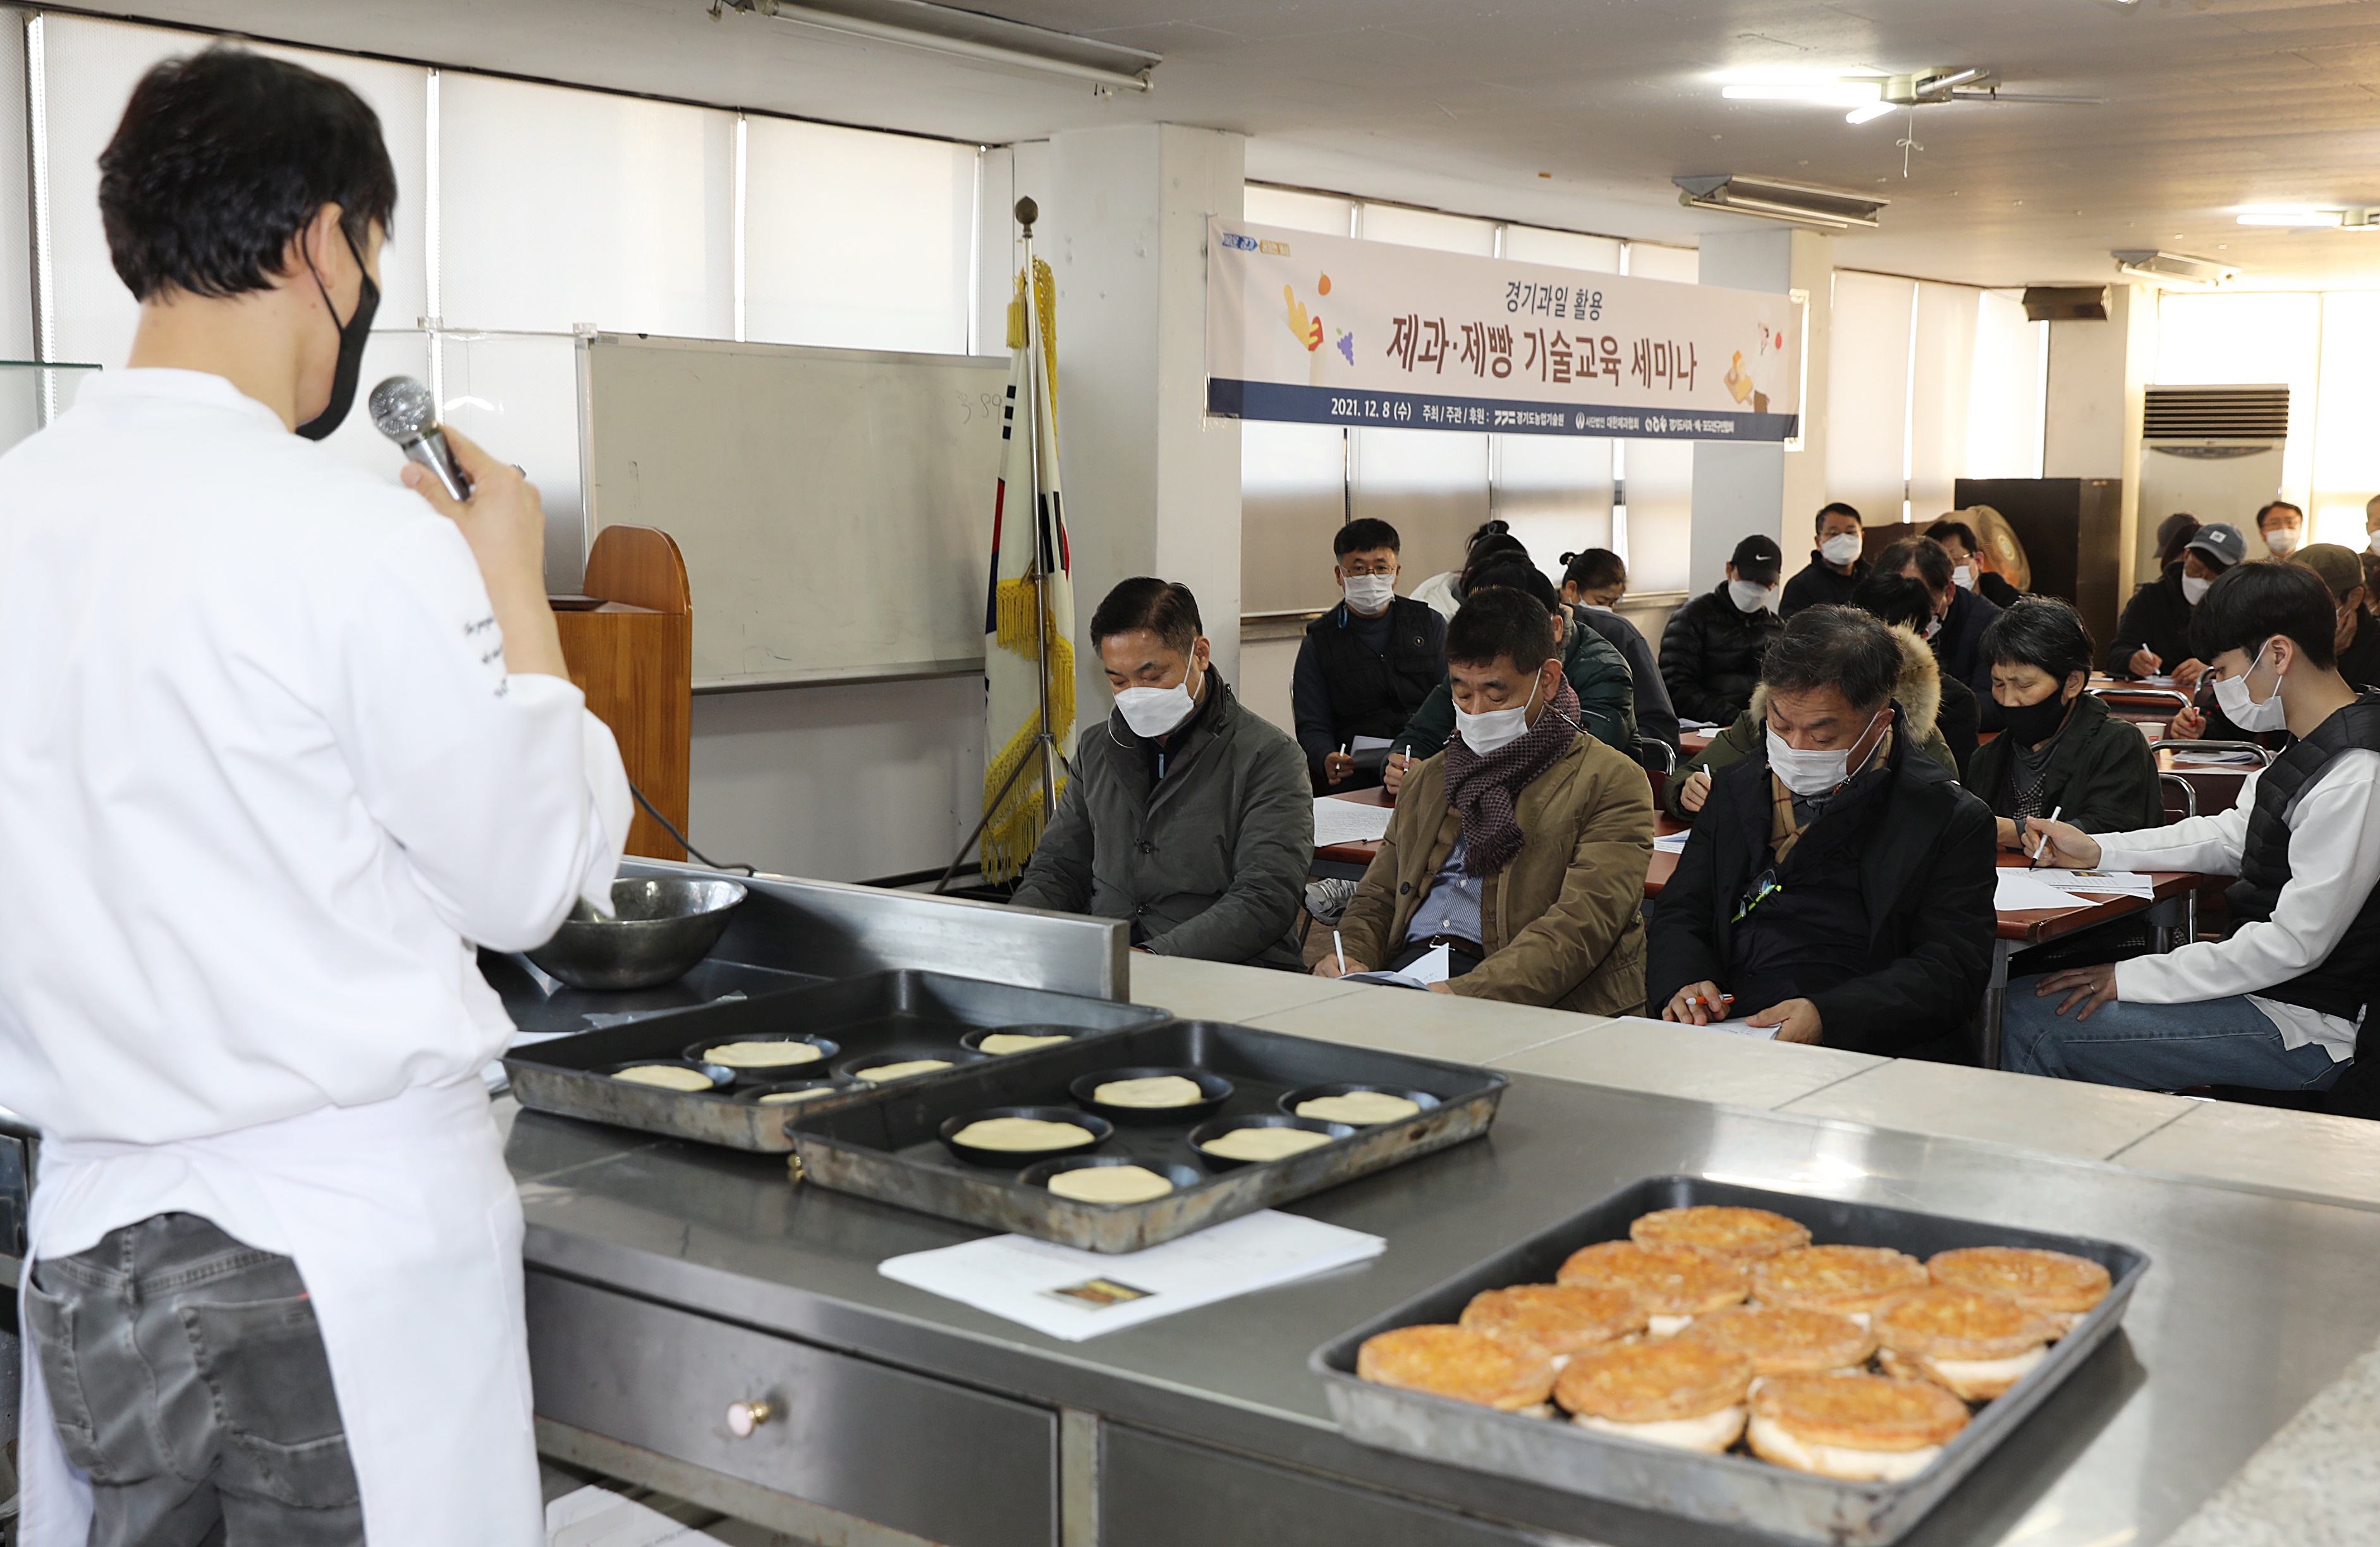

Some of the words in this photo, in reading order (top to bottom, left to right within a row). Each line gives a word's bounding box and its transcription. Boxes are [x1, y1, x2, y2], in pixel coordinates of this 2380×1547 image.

[1506, 281, 1568, 318] 경기과일
[1574, 289, 1602, 321] 활용
[1386, 313, 1513, 379] 제과·제빵
[1523, 327, 1621, 387] 기술교육
[1631, 337, 1697, 391] 세미나
[1331, 397, 1361, 417] 2021.
[1365, 399, 1379, 418] 12.
[1382, 401, 1391, 418] 8
[1394, 401, 1412, 422] (수)
